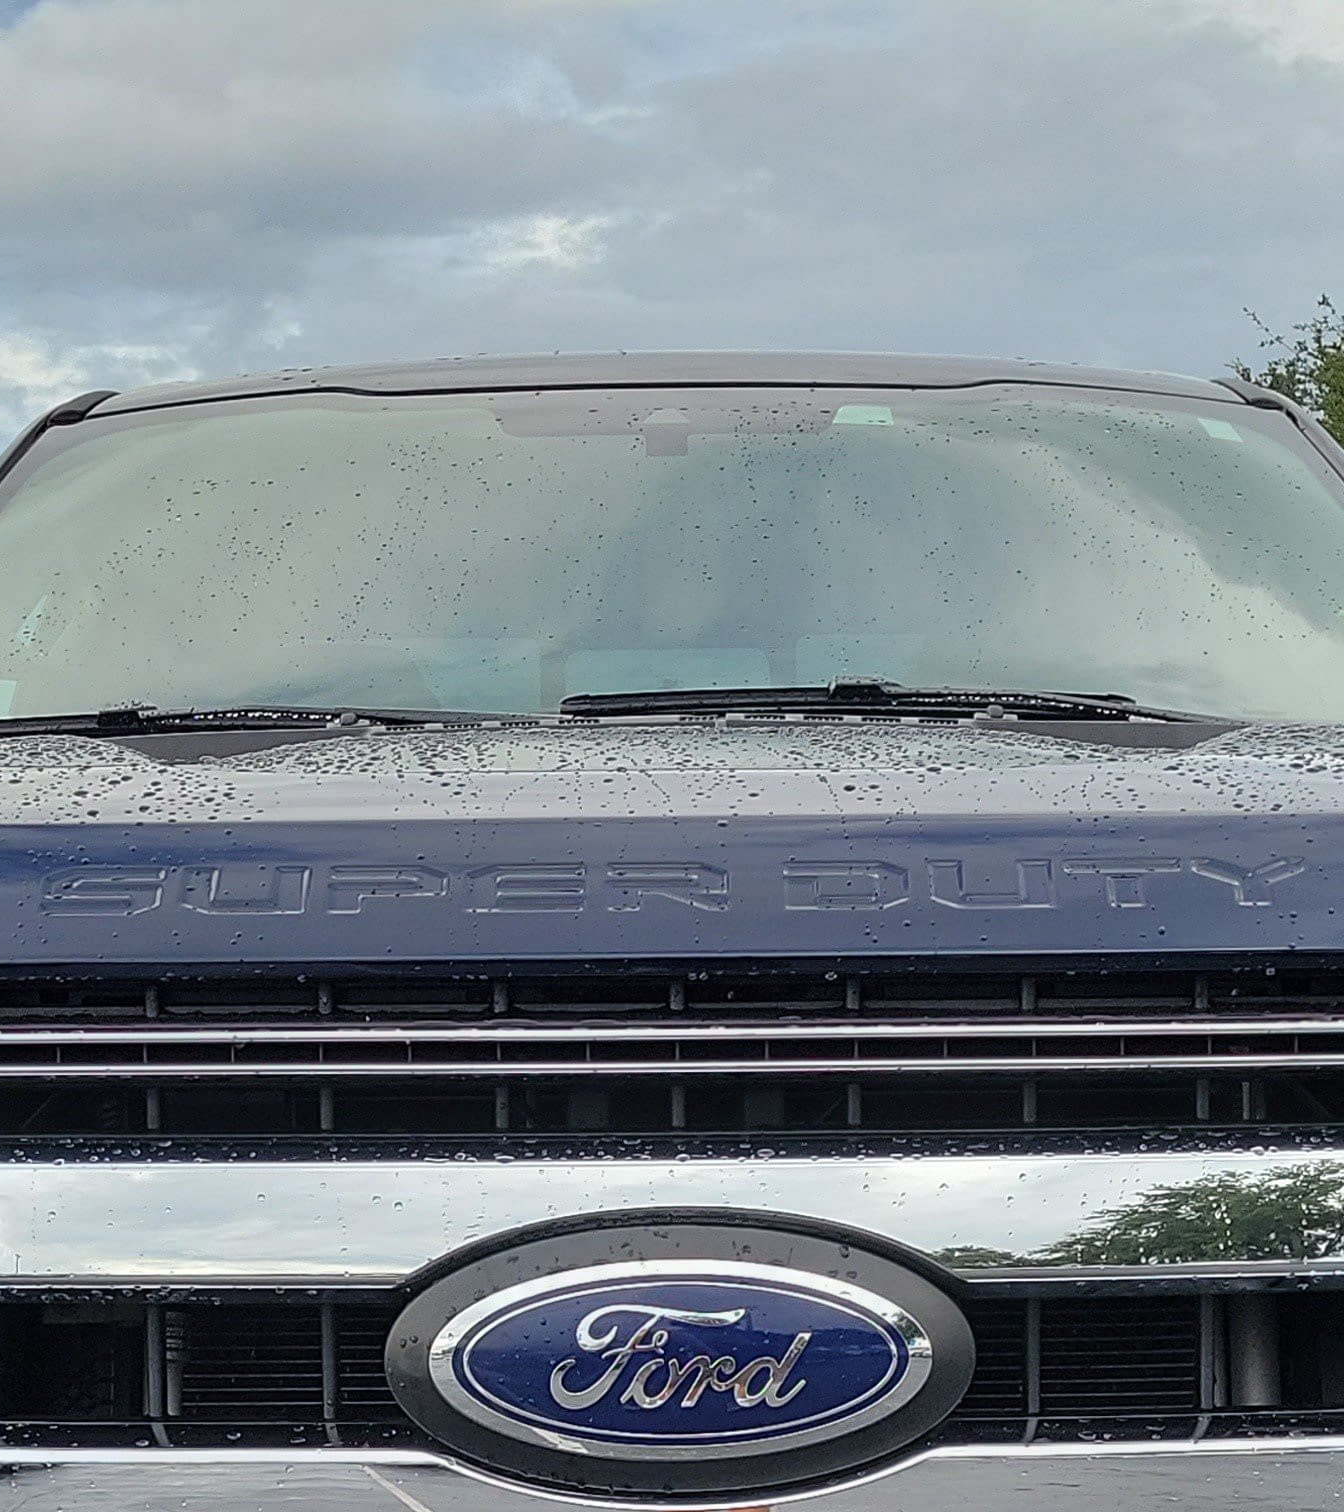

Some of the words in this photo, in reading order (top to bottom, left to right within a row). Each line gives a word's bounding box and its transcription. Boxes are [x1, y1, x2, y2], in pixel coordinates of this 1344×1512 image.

[39, 863, 730, 917] SUPER
[782, 856, 1306, 910] DUTY
[549, 1303, 812, 1410] Ford
